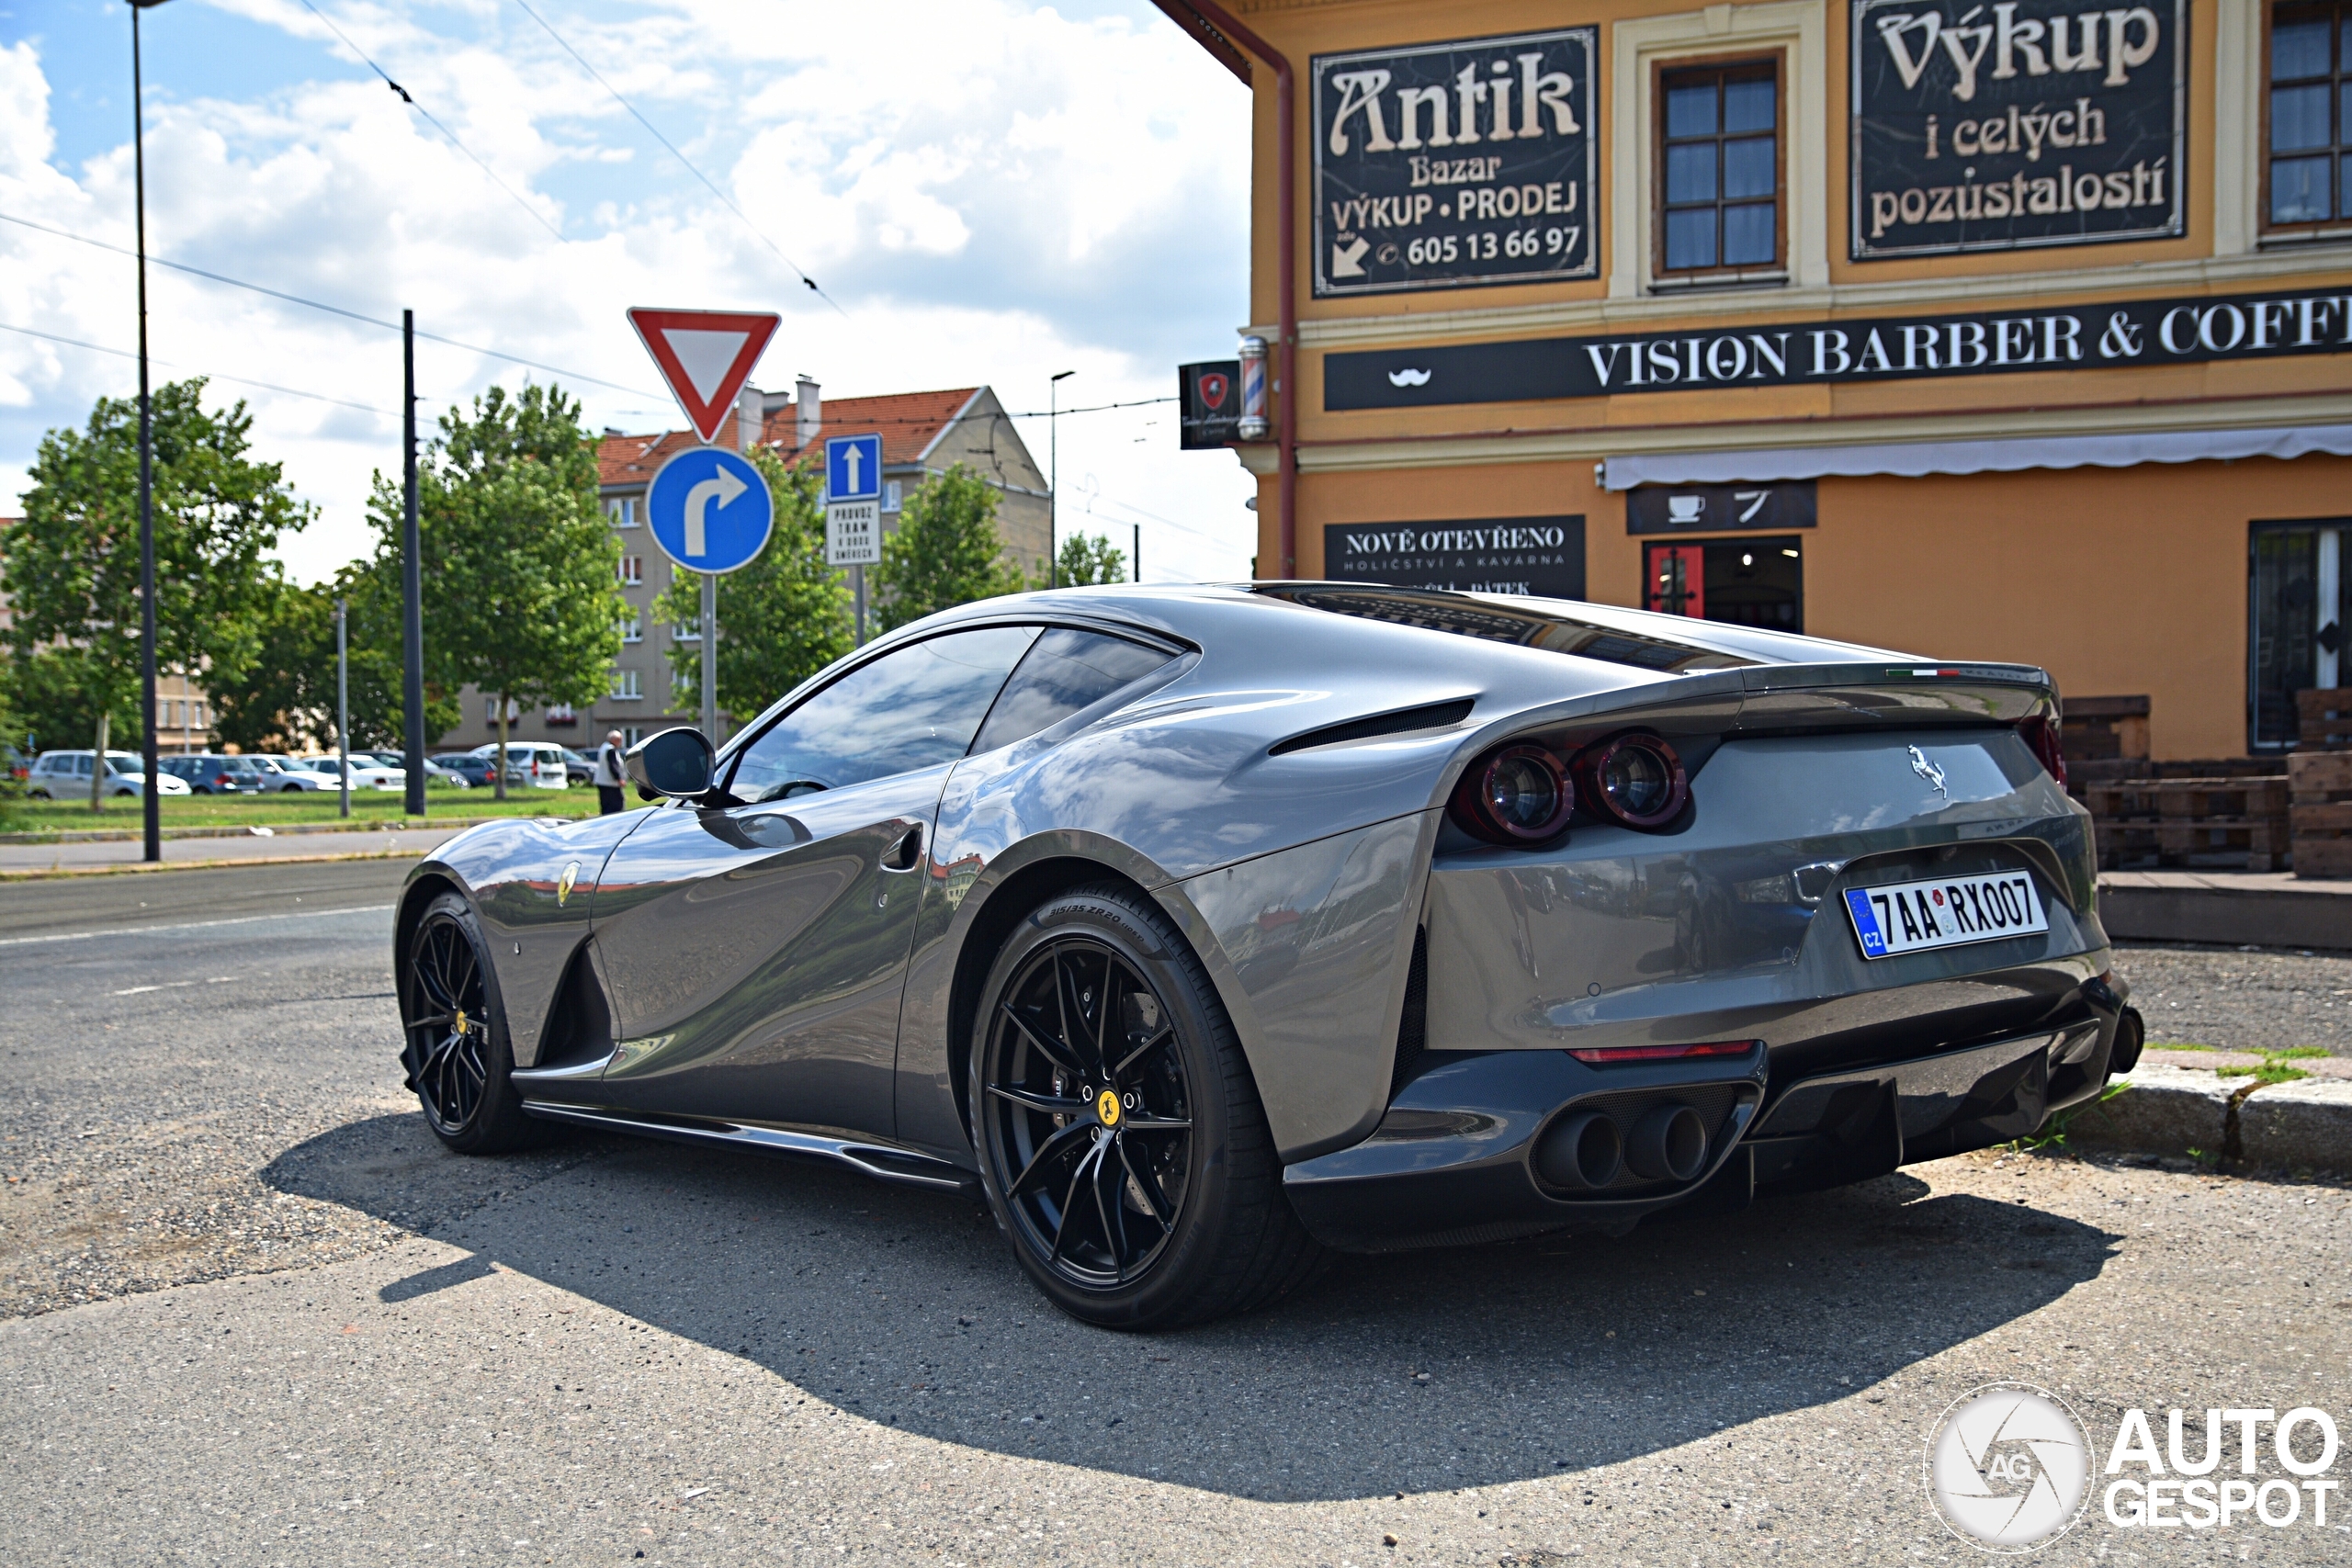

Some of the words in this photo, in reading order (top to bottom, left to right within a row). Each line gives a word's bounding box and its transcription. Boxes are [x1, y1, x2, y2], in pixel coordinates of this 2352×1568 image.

[1876, 2, 2160, 102] Výkup
[1331, 52, 1581, 156] Antik
[1925, 114, 1939, 160] i
[1952, 96, 2108, 163] celých
[1408, 154, 1501, 187] Bazar
[1331, 192, 1433, 231] VÝKUP
[1457, 181, 1577, 221] PRODEJ
[1871, 156, 2168, 238] pozůstalostí
[1408, 235, 1459, 265] 605
[1465, 231, 1498, 261] 13
[1504, 228, 1540, 258] 66
[1545, 226, 1581, 255] 97
[1582, 332, 1793, 388] VISION
[1804, 314, 2085, 376] BARBER
[2098, 310, 2144, 359] &
[1344, 556, 1444, 571] HOLIČSTVÍ
[1455, 557, 1465, 569] A
[1476, 553, 1565, 567] KAVÁRNA
[1346, 528, 1416, 555] NOVĚ
[1420, 525, 1565, 551] OTEVŘENO
[1049, 905, 1086, 917] 315/35
[1087, 906, 1121, 923] ZR20
[1871, 890, 1941, 944] 7AA
[1946, 878, 2033, 933] RX007
[1863, 931, 1882, 948] CZ
